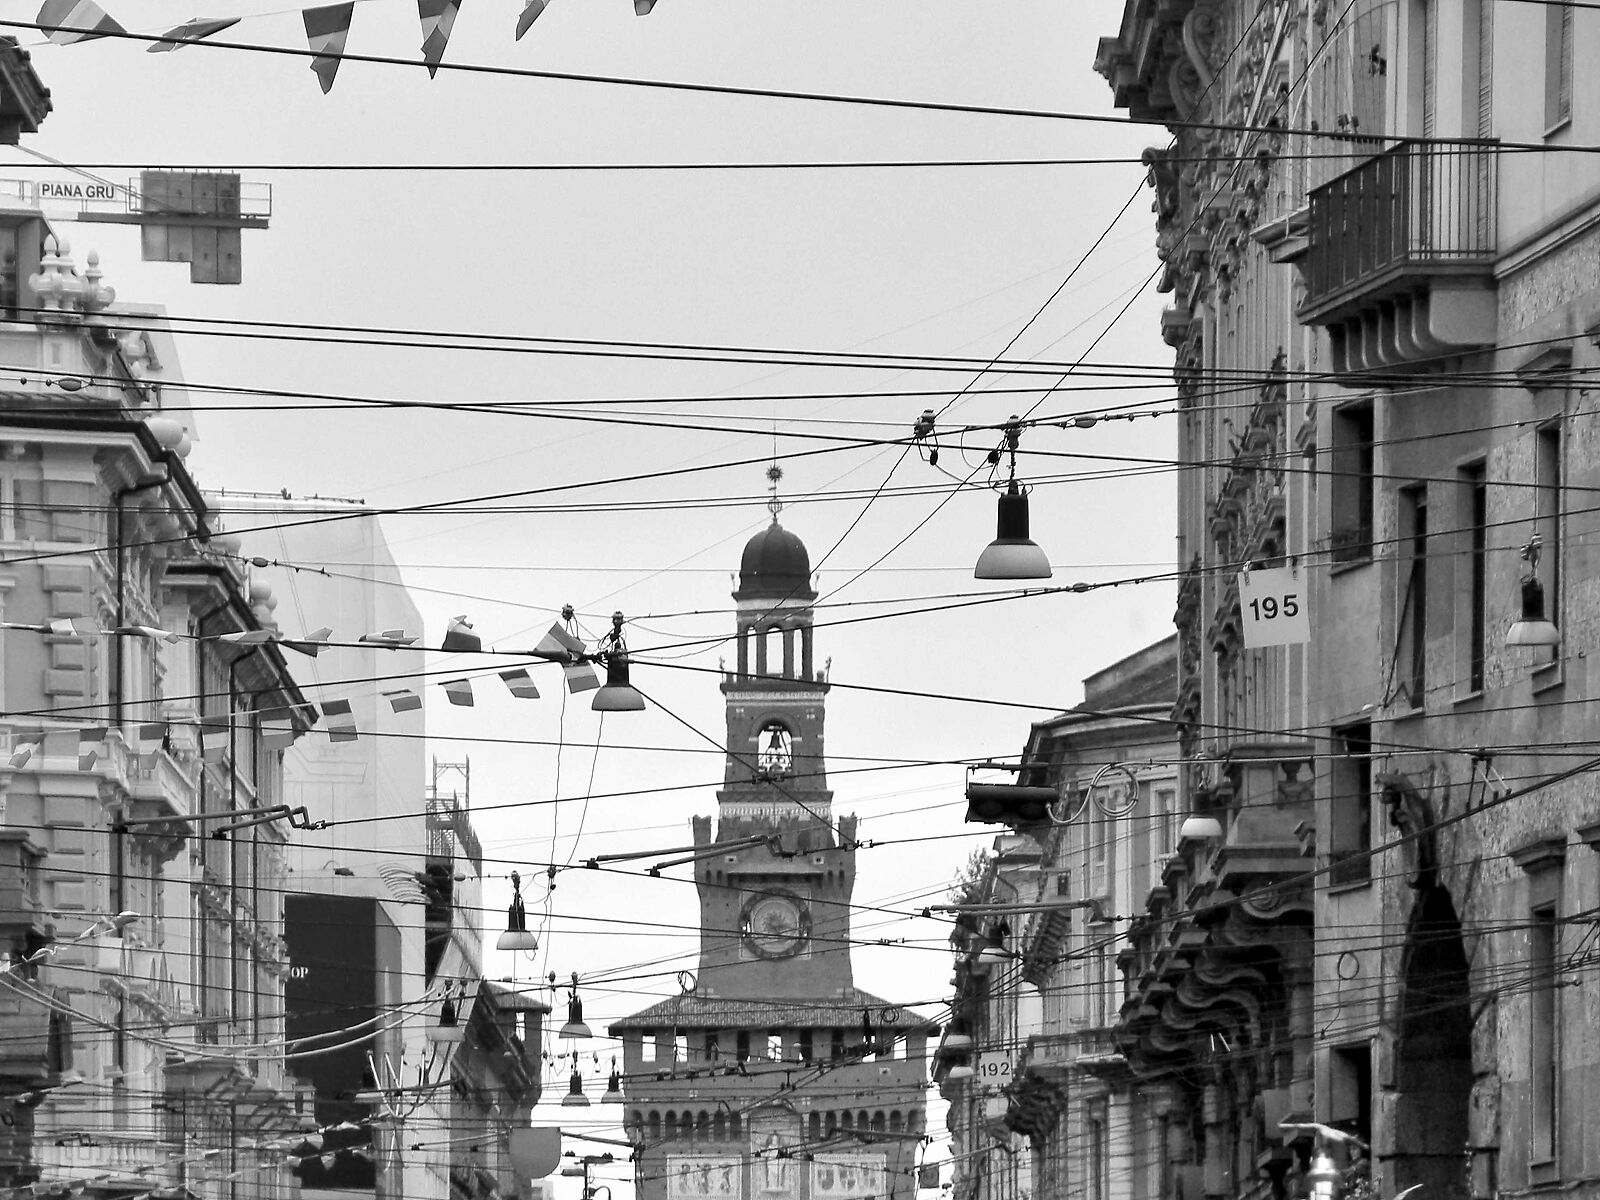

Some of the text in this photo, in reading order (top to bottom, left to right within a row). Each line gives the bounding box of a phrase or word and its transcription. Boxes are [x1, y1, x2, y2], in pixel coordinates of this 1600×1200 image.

[42, 183, 115, 199] PIANA GRU
[1249, 594, 1299, 621] 195
[291, 966, 309, 978] OP
[980, 1062, 1011, 1077] 192
